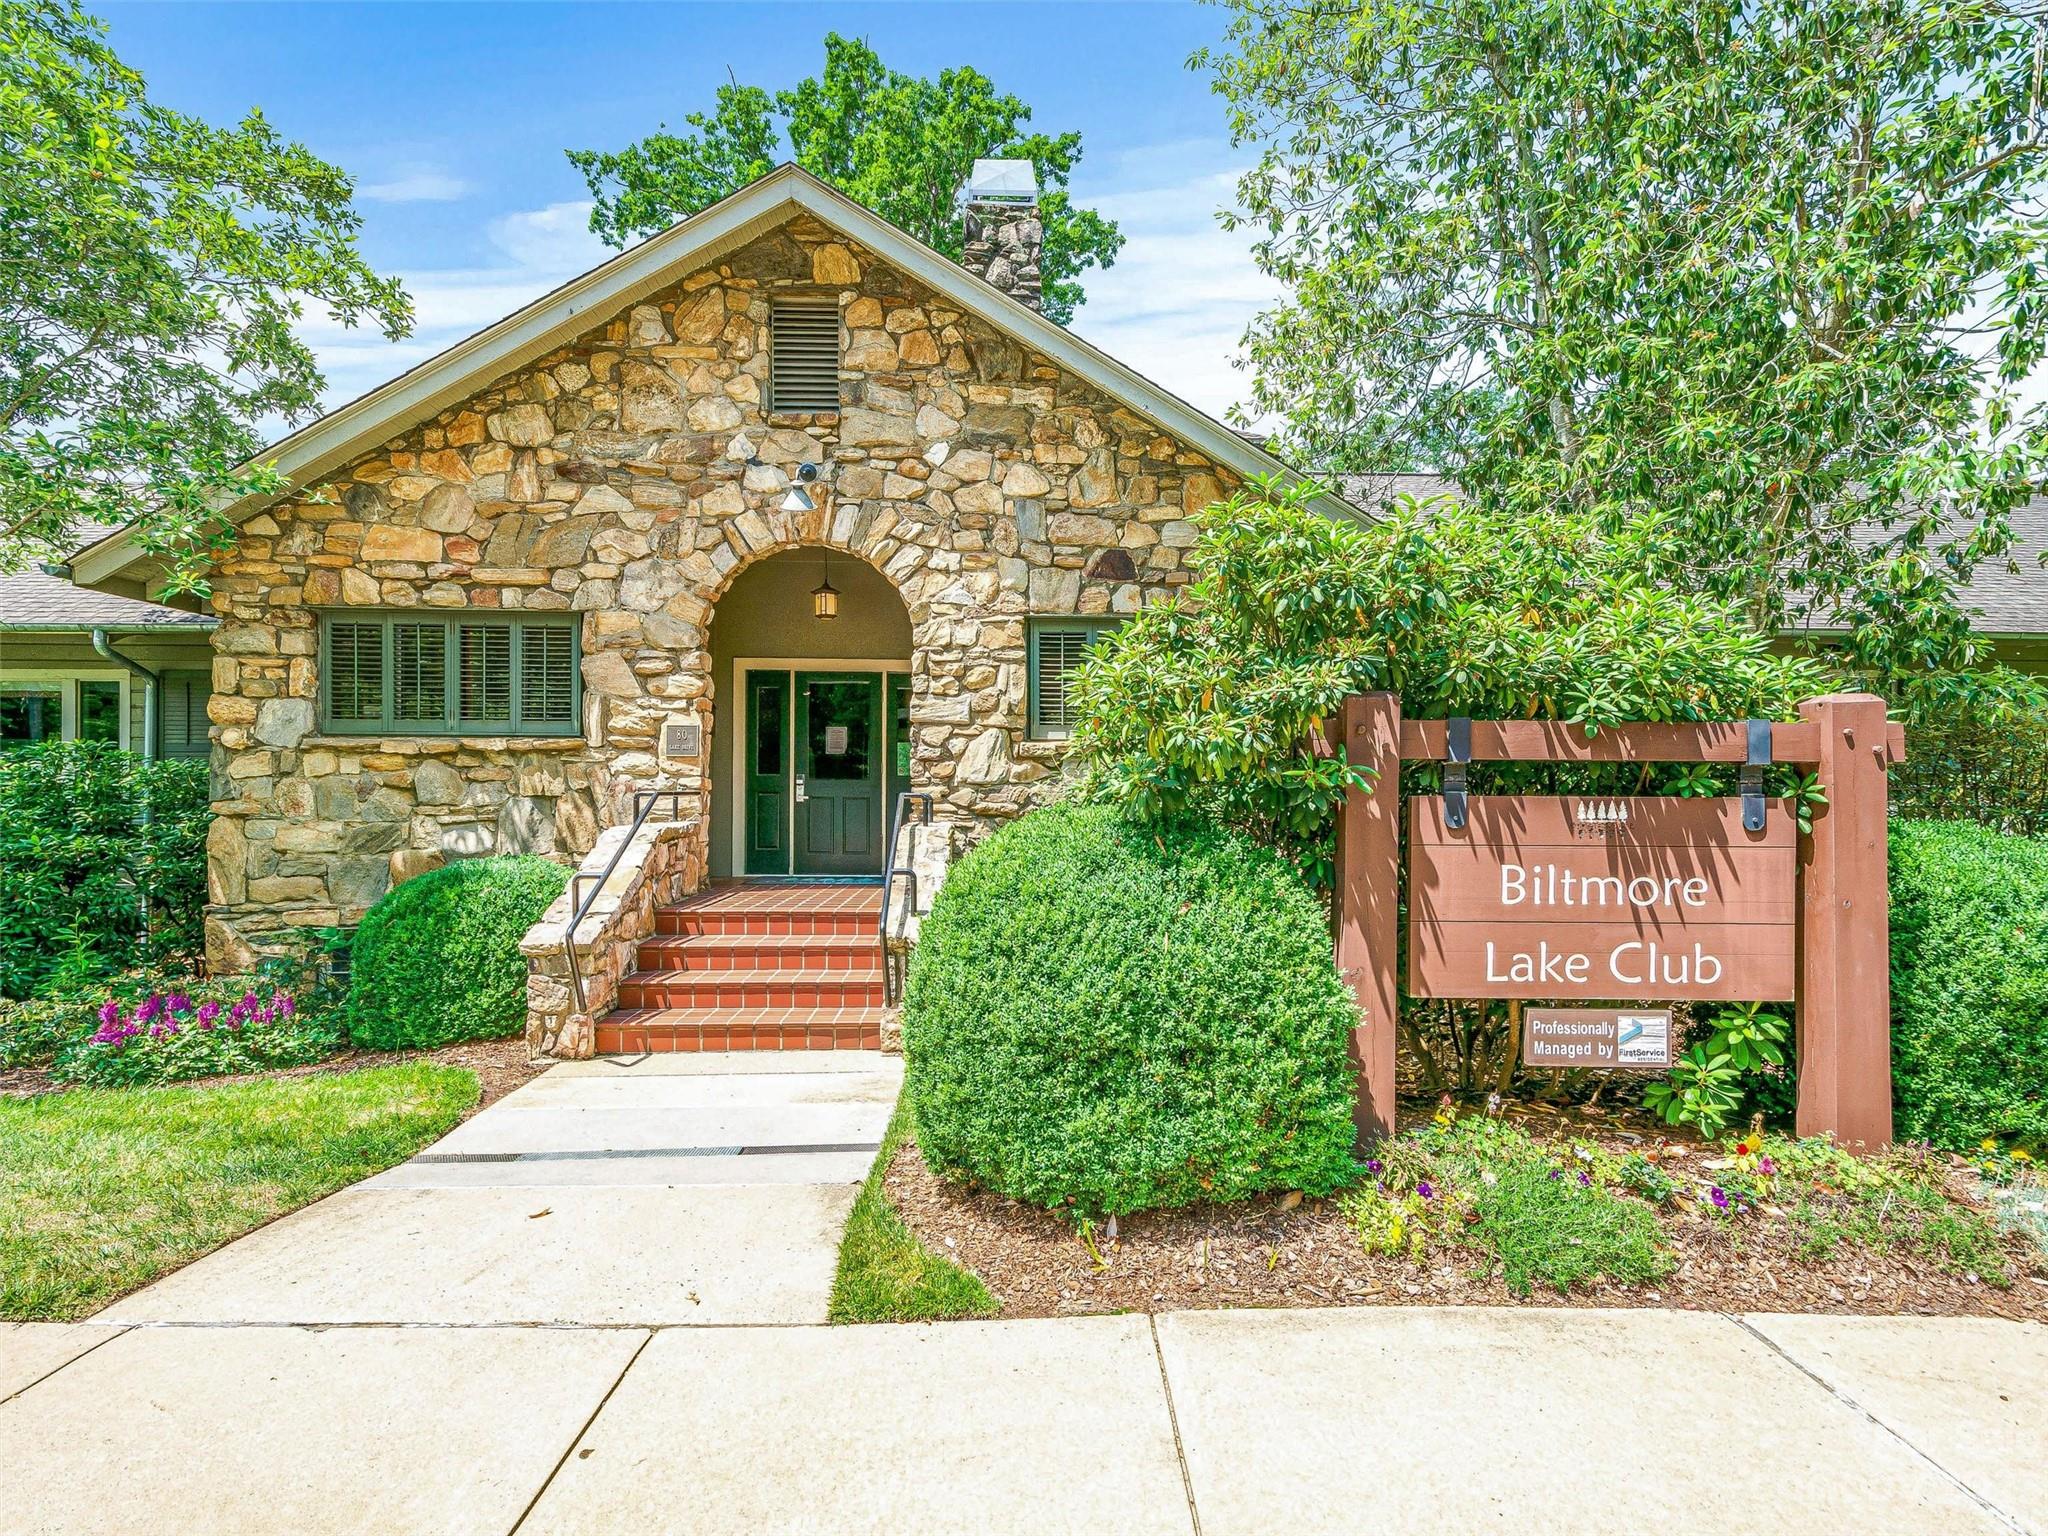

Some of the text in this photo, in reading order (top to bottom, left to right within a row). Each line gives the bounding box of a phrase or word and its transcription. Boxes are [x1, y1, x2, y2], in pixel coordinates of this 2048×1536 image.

[676, 729, 688, 741] 80
[1500, 863, 1709, 908] Biltmore
[1487, 941, 1723, 984] Lake Club
[1532, 1020, 1615, 1038] Professionally
[1534, 1041, 1614, 1058] Managed by
[1619, 1048, 1665, 1057] FirstService
